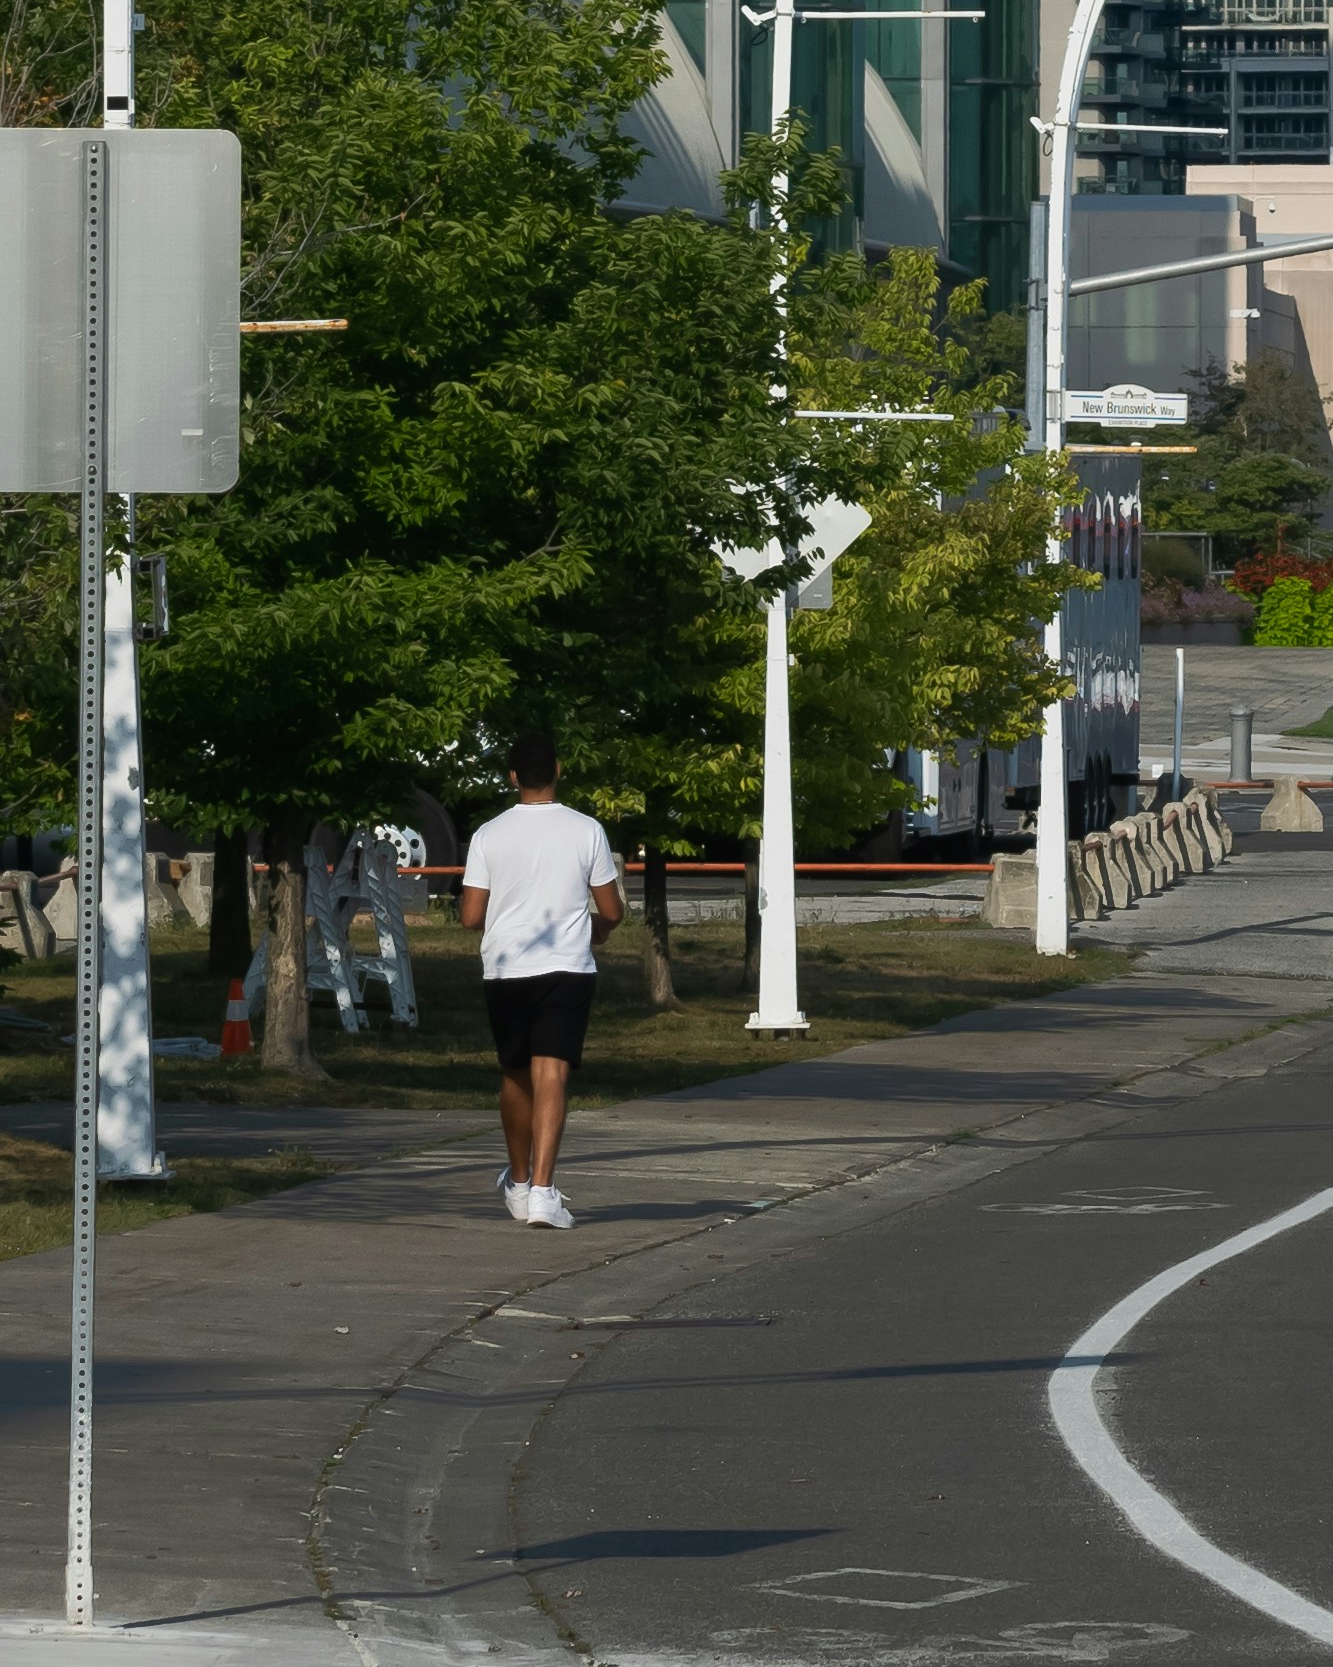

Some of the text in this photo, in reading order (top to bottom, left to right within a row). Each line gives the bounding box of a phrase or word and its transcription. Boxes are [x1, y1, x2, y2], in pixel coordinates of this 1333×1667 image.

[1082, 401, 1176, 417] New Brunswick Way
